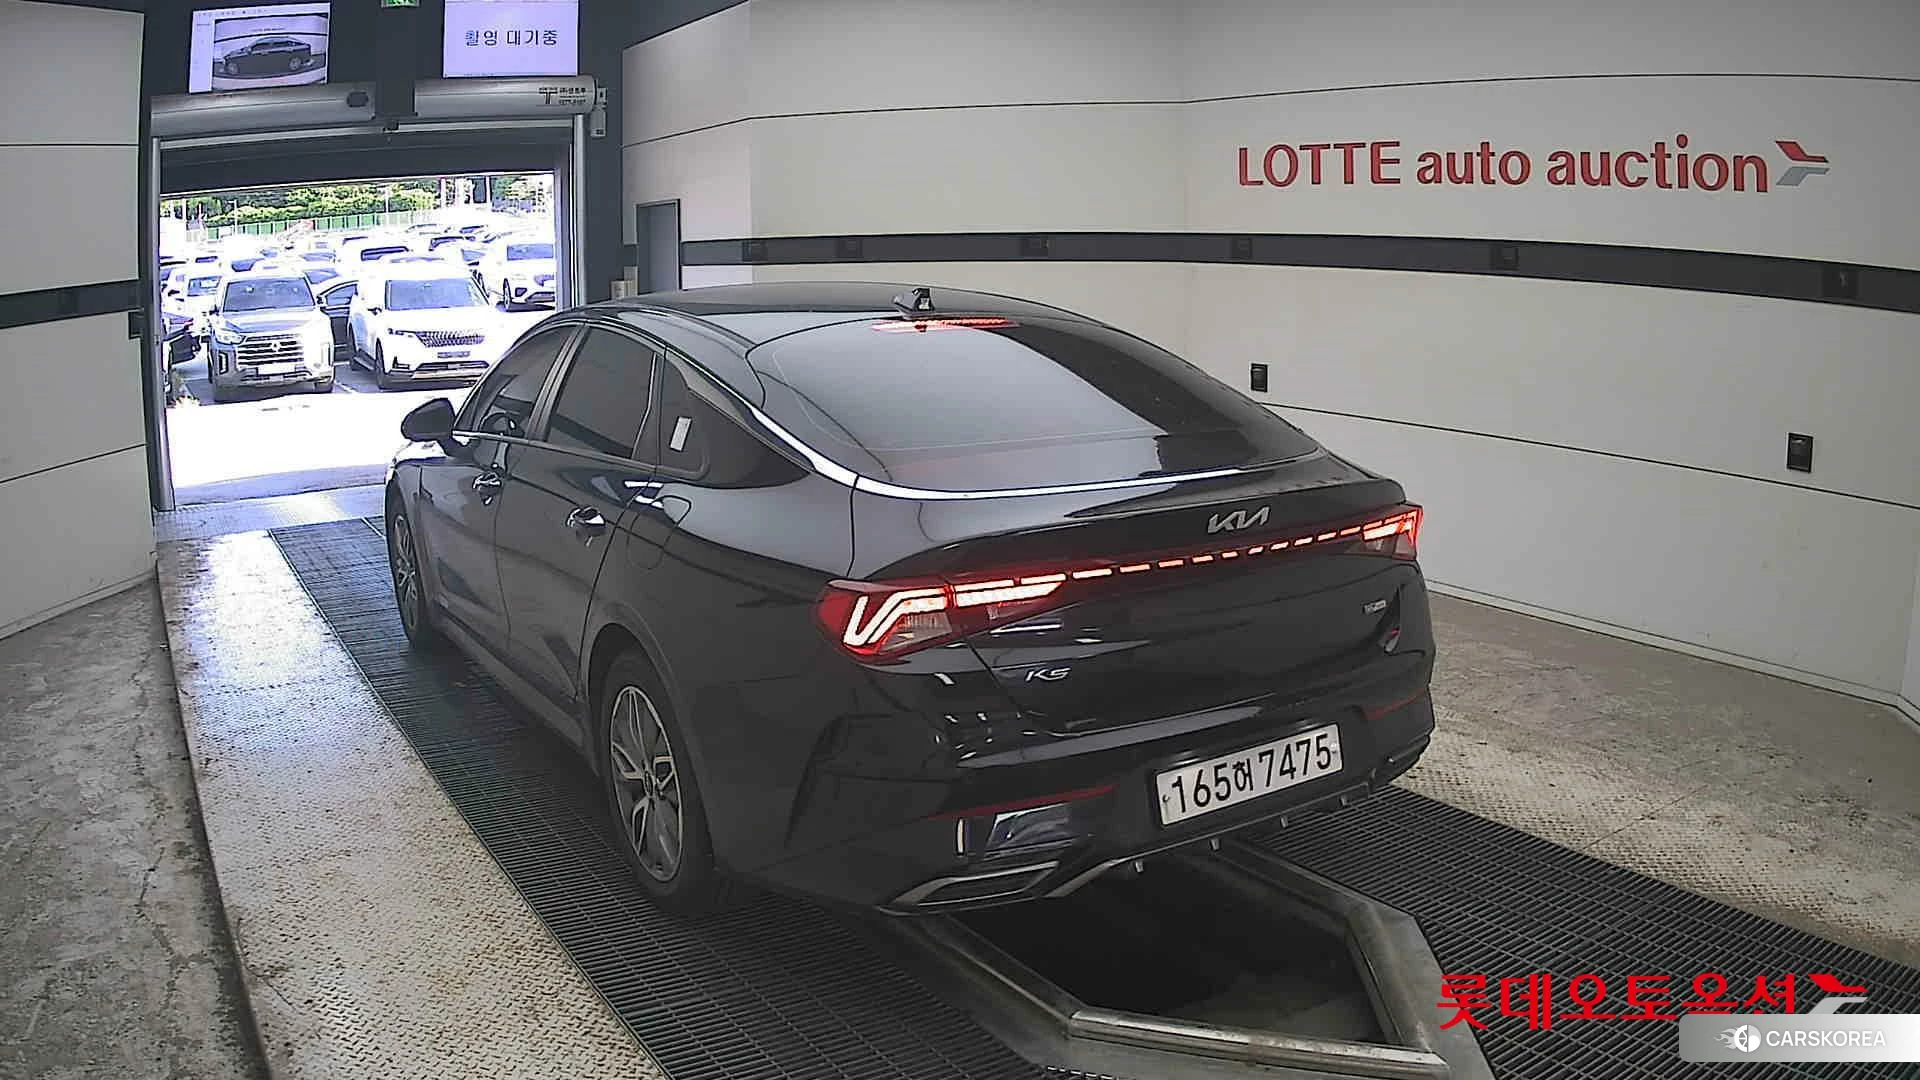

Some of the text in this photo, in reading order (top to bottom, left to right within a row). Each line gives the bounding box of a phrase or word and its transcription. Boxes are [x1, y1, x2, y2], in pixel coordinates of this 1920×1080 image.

[506, 29, 558, 46] 대기중
[1238, 133, 1769, 193] LOTTE auto auction
[1207, 506, 1270, 533] KIA
[1024, 667, 1071, 681] K5
